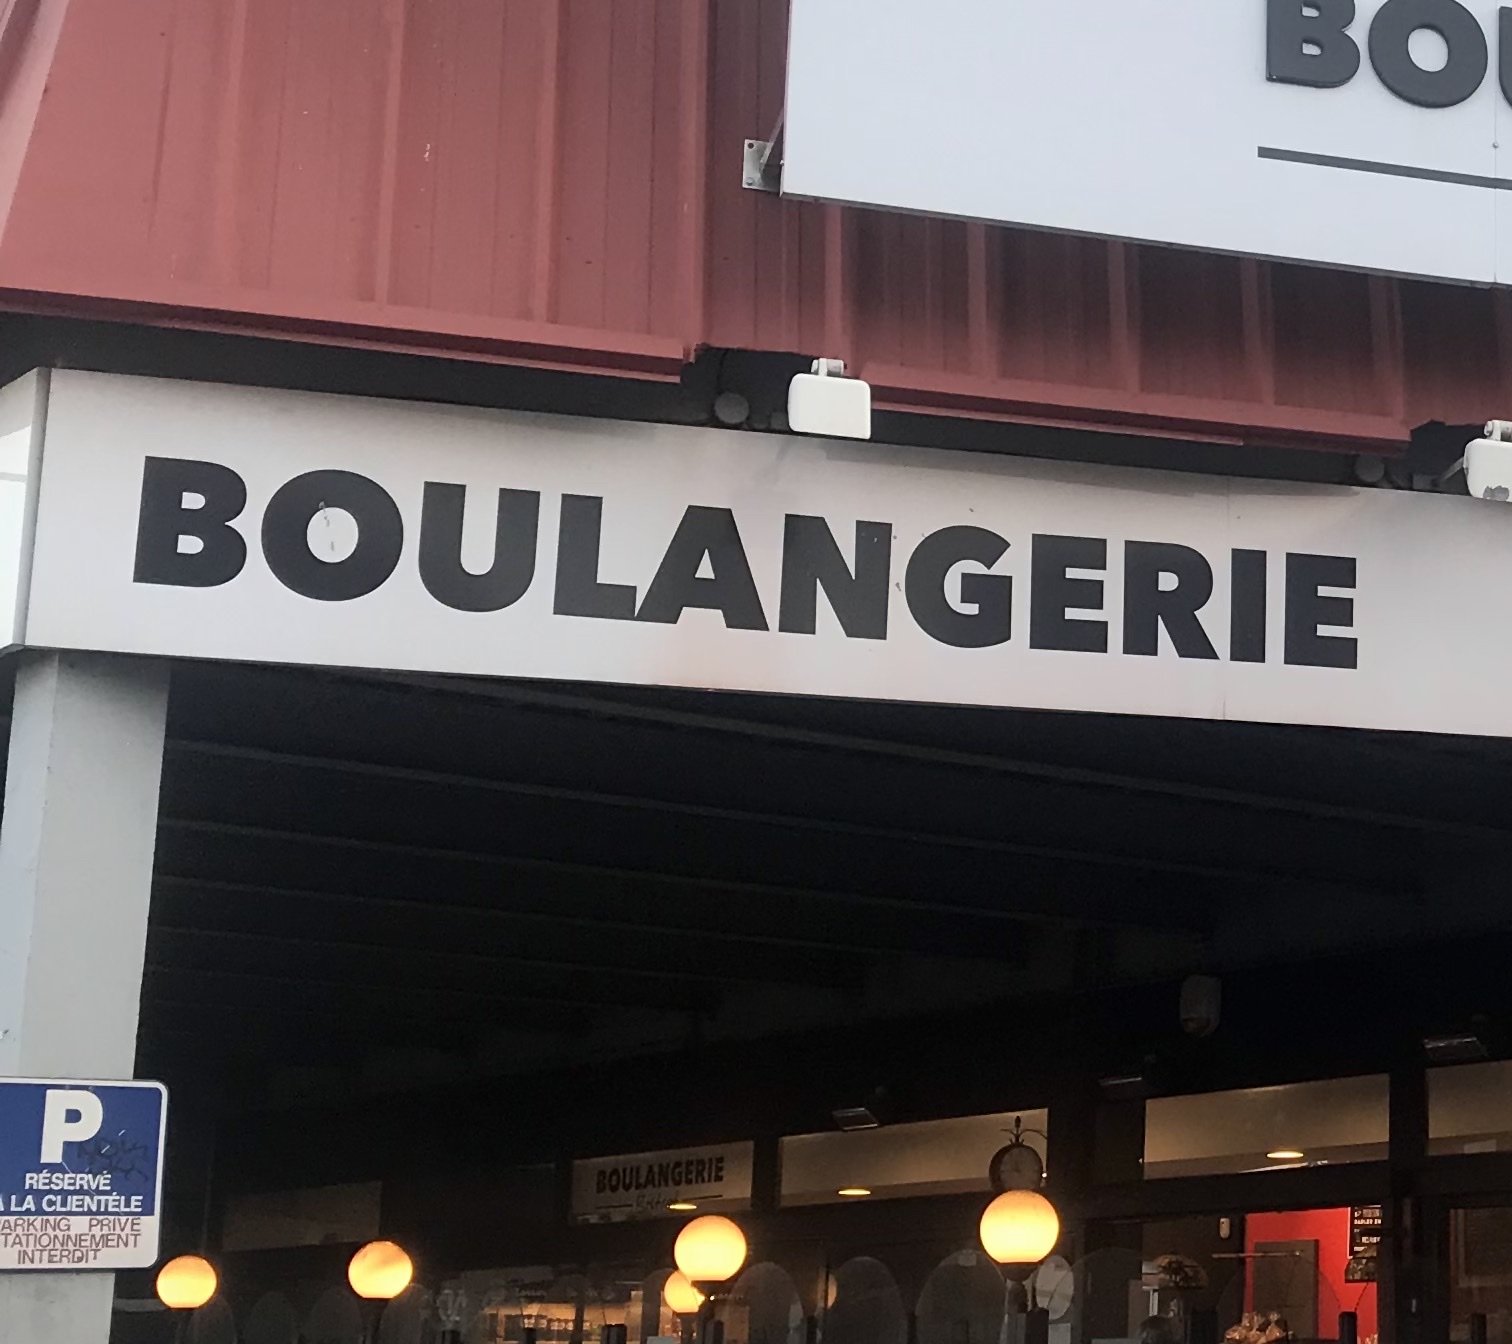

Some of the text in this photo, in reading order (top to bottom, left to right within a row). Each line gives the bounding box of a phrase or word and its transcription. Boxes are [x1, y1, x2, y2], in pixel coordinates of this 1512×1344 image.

[132, 455, 1358, 670] BOULANGERIE
[40, 1089, 104, 1164] P
[24, 1168, 112, 1191] RÉSERVÉ
[595, 1156, 725, 1194] BOULANGERIE
[10, 1194, 36, 1212] LA
[0, 1216, 71, 1233] ARKING
[0, 1232, 142, 1249] TATIONNEMENT
[17, 1248, 102, 1265] INTERDIT
